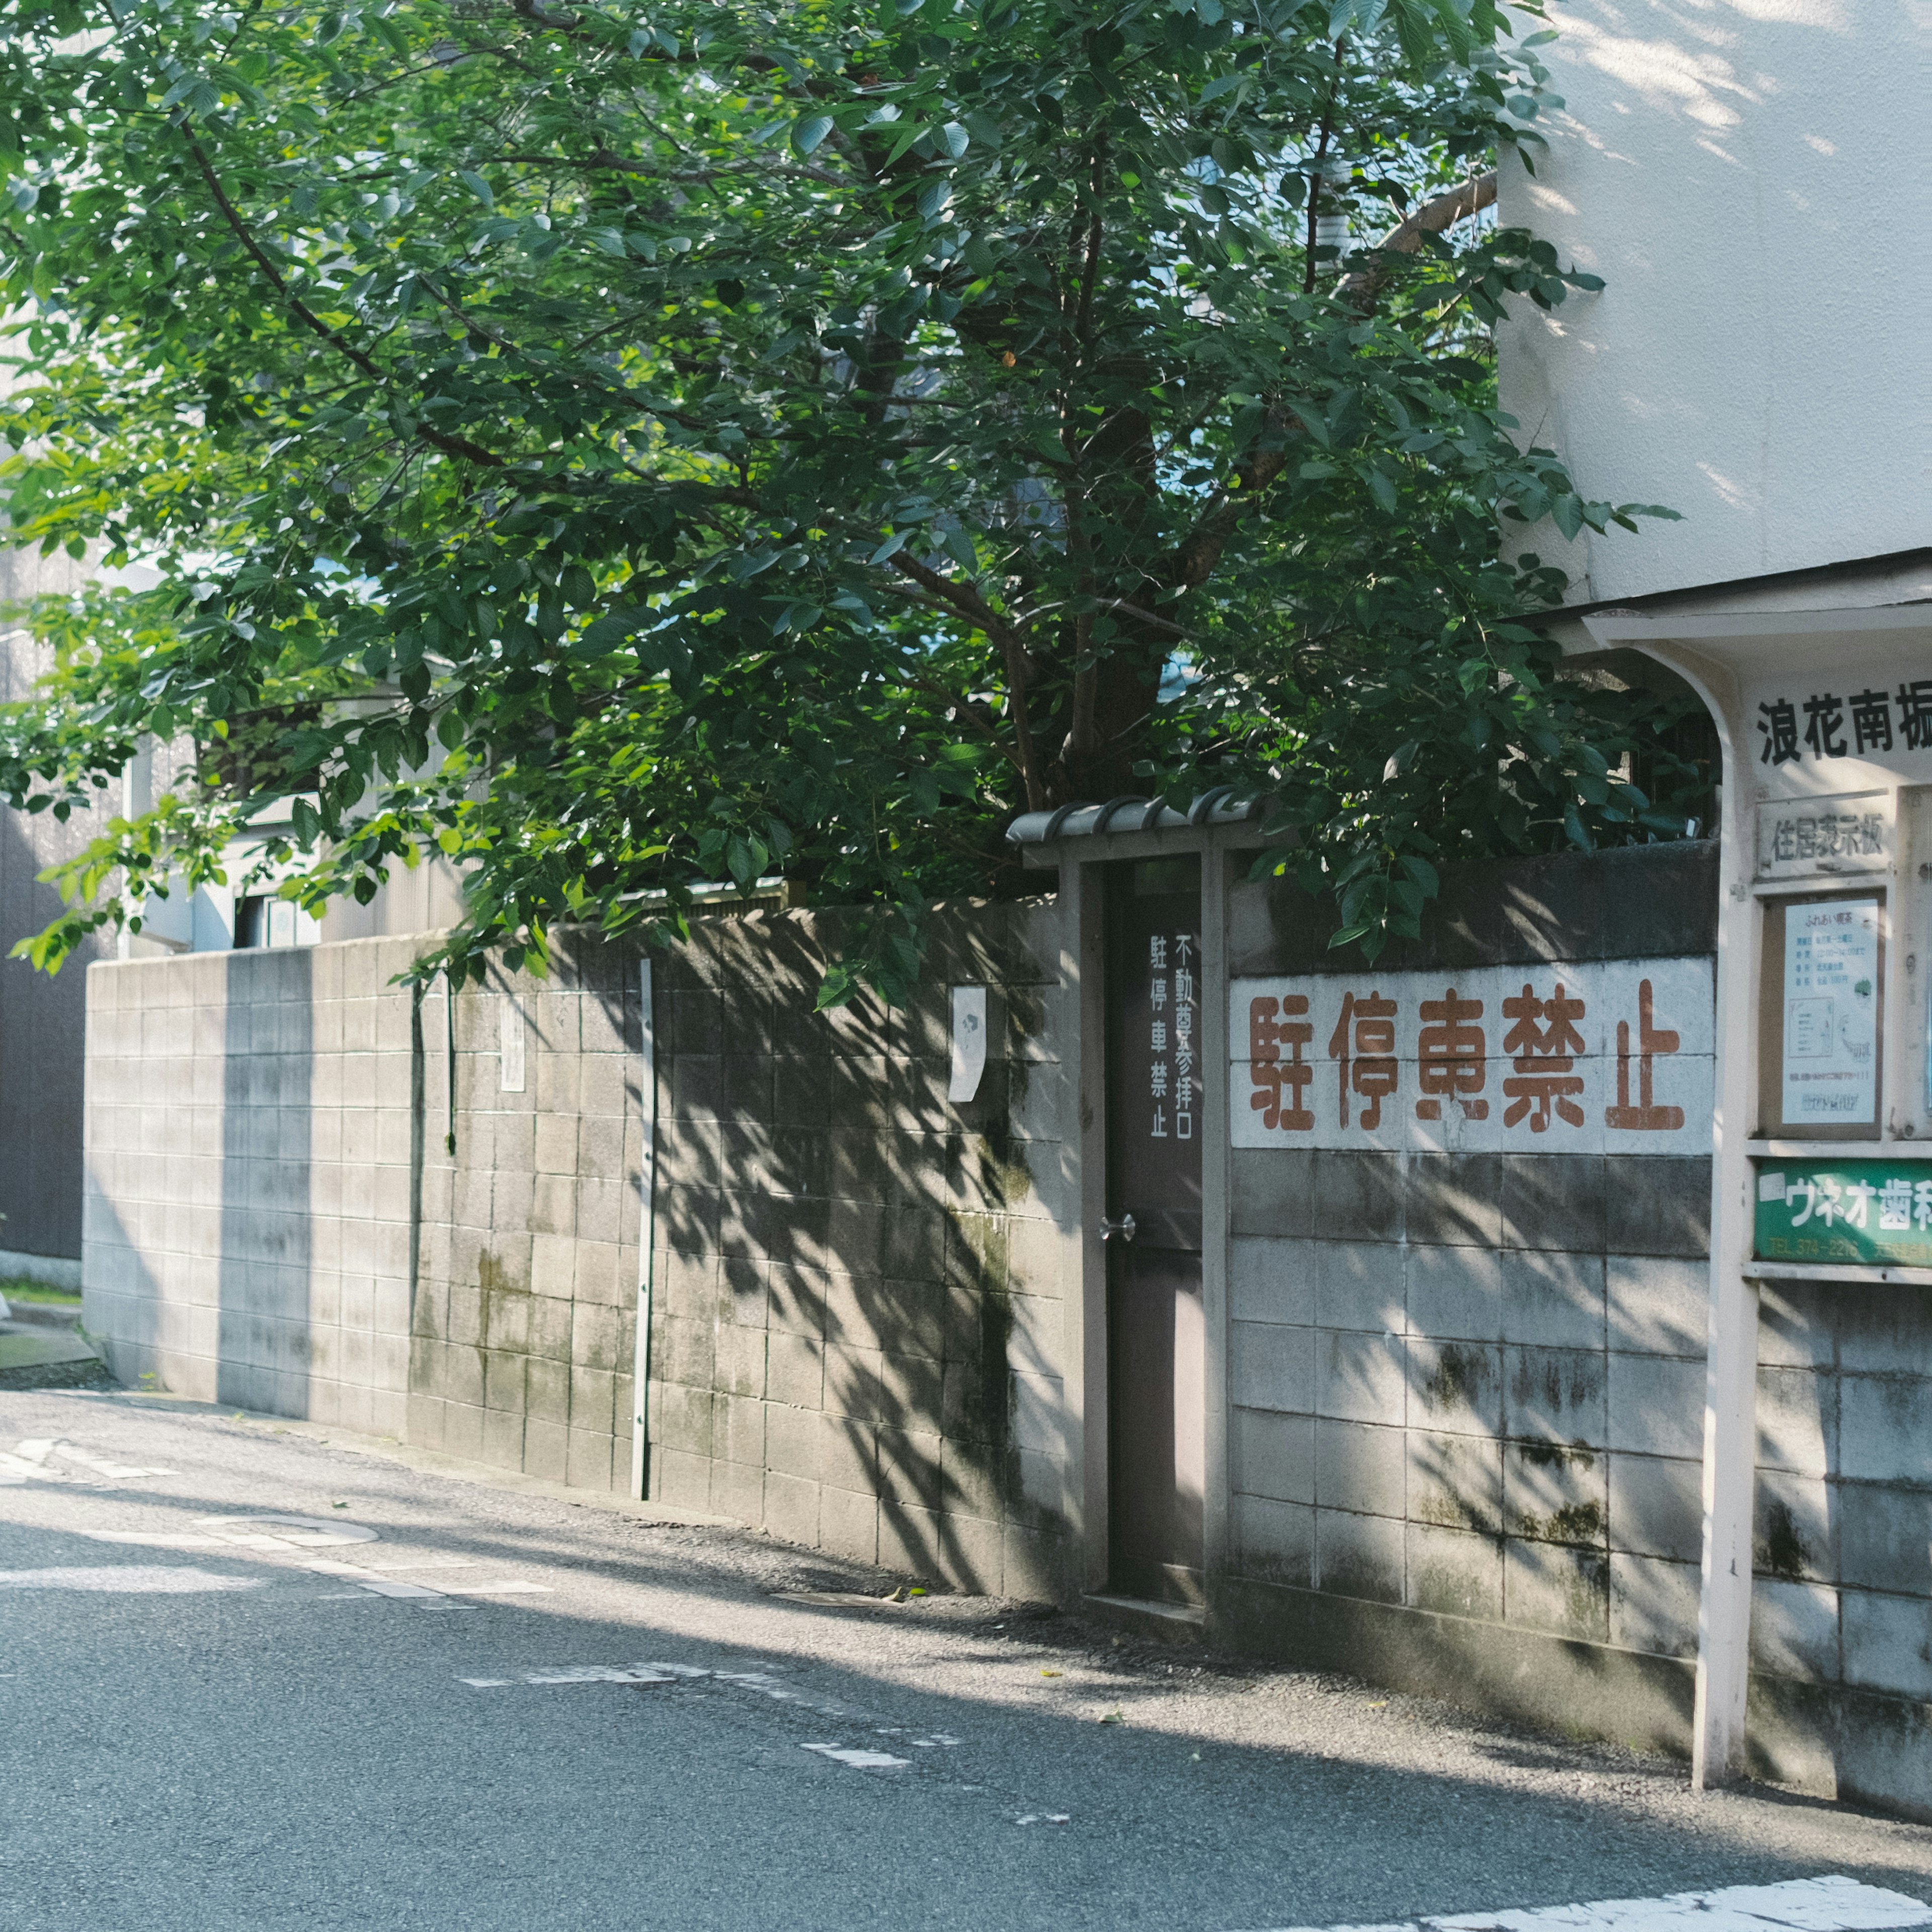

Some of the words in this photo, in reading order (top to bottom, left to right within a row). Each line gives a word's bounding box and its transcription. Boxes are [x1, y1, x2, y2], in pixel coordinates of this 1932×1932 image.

[1151, 936, 1167, 1138] 駐停車禁止
[1175, 935, 1192, 1139] 不動尊参拝口
[1250, 979, 1685, 1133] 駐停車禁止
